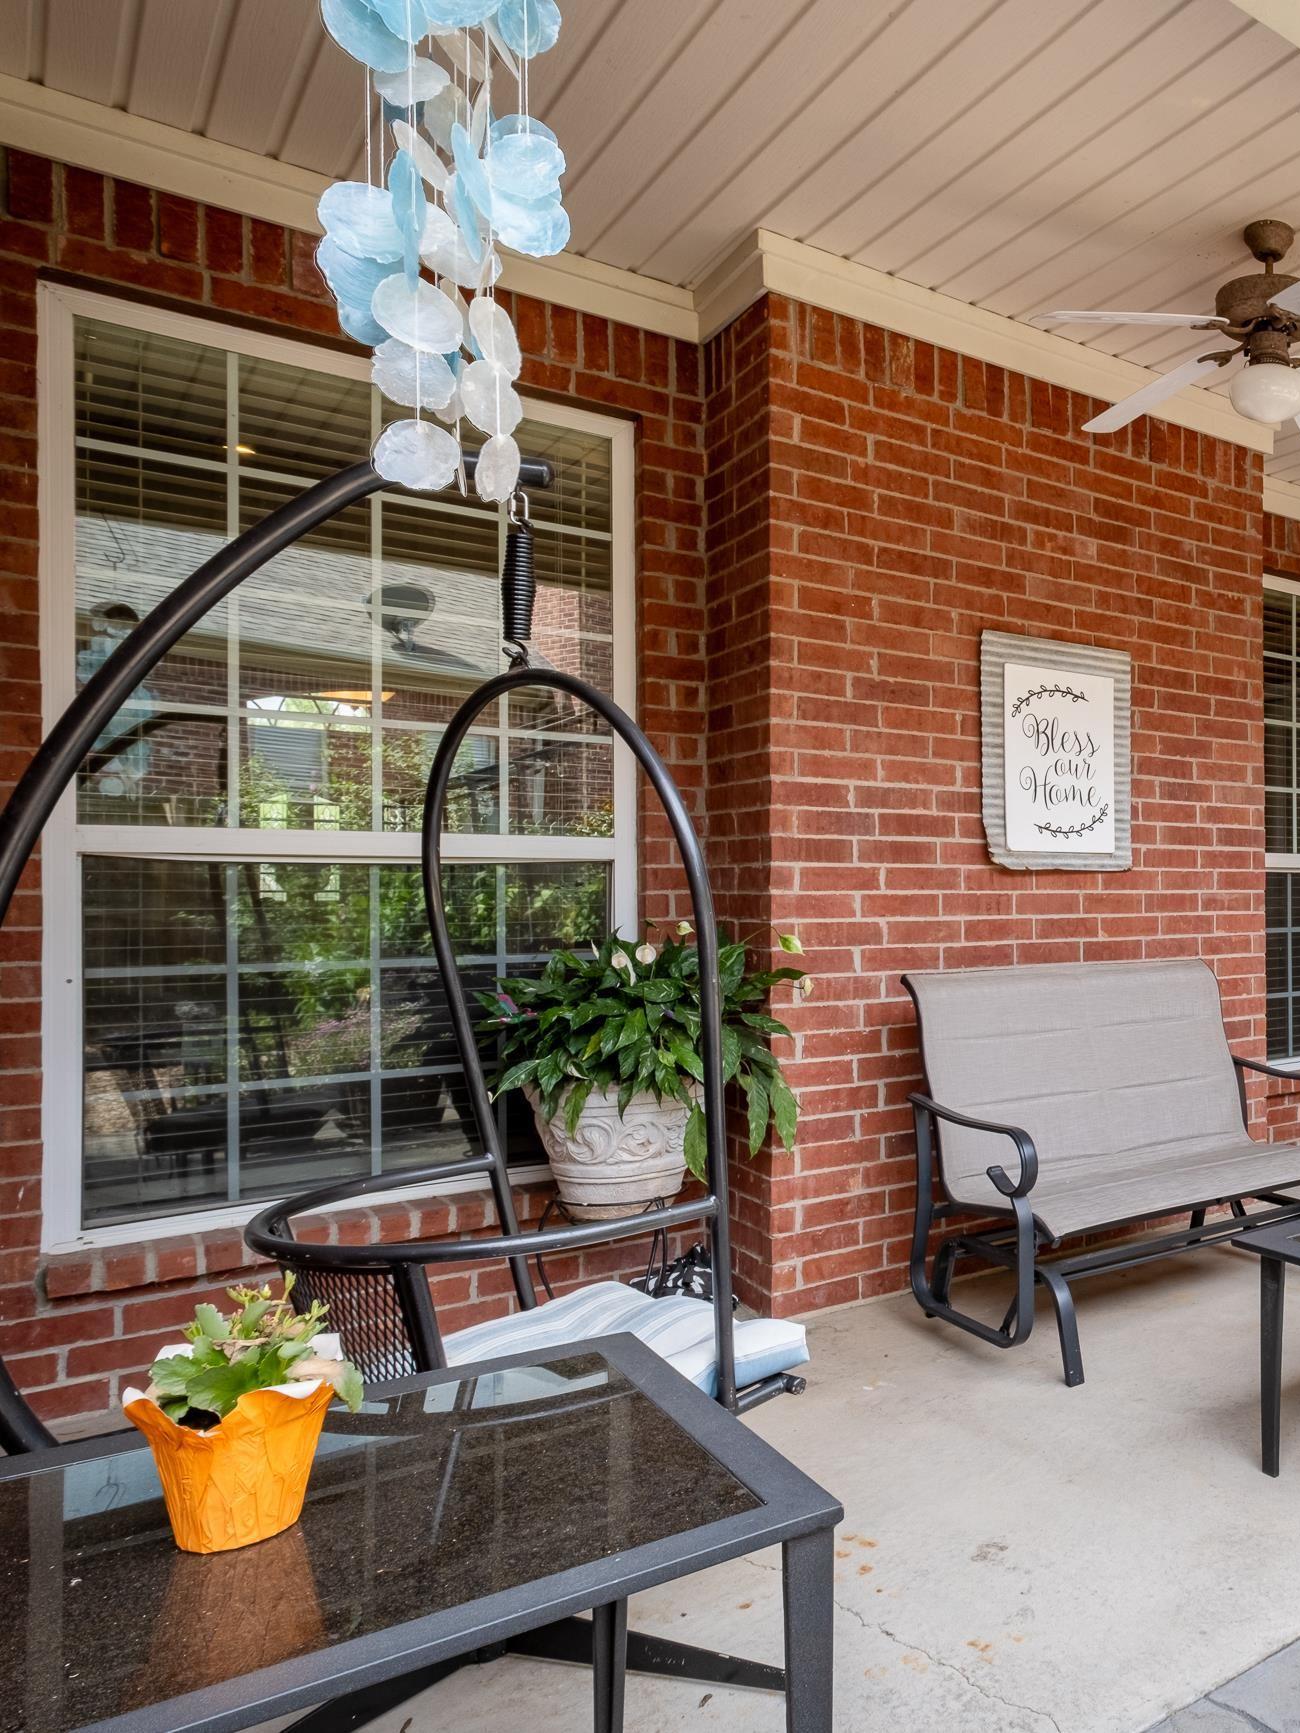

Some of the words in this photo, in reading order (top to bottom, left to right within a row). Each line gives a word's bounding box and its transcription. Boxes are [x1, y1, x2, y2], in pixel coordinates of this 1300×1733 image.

[1022, 713, 1100, 756] Bless
[1019, 765, 1101, 810] Home
[1054, 758, 1095, 780] our
